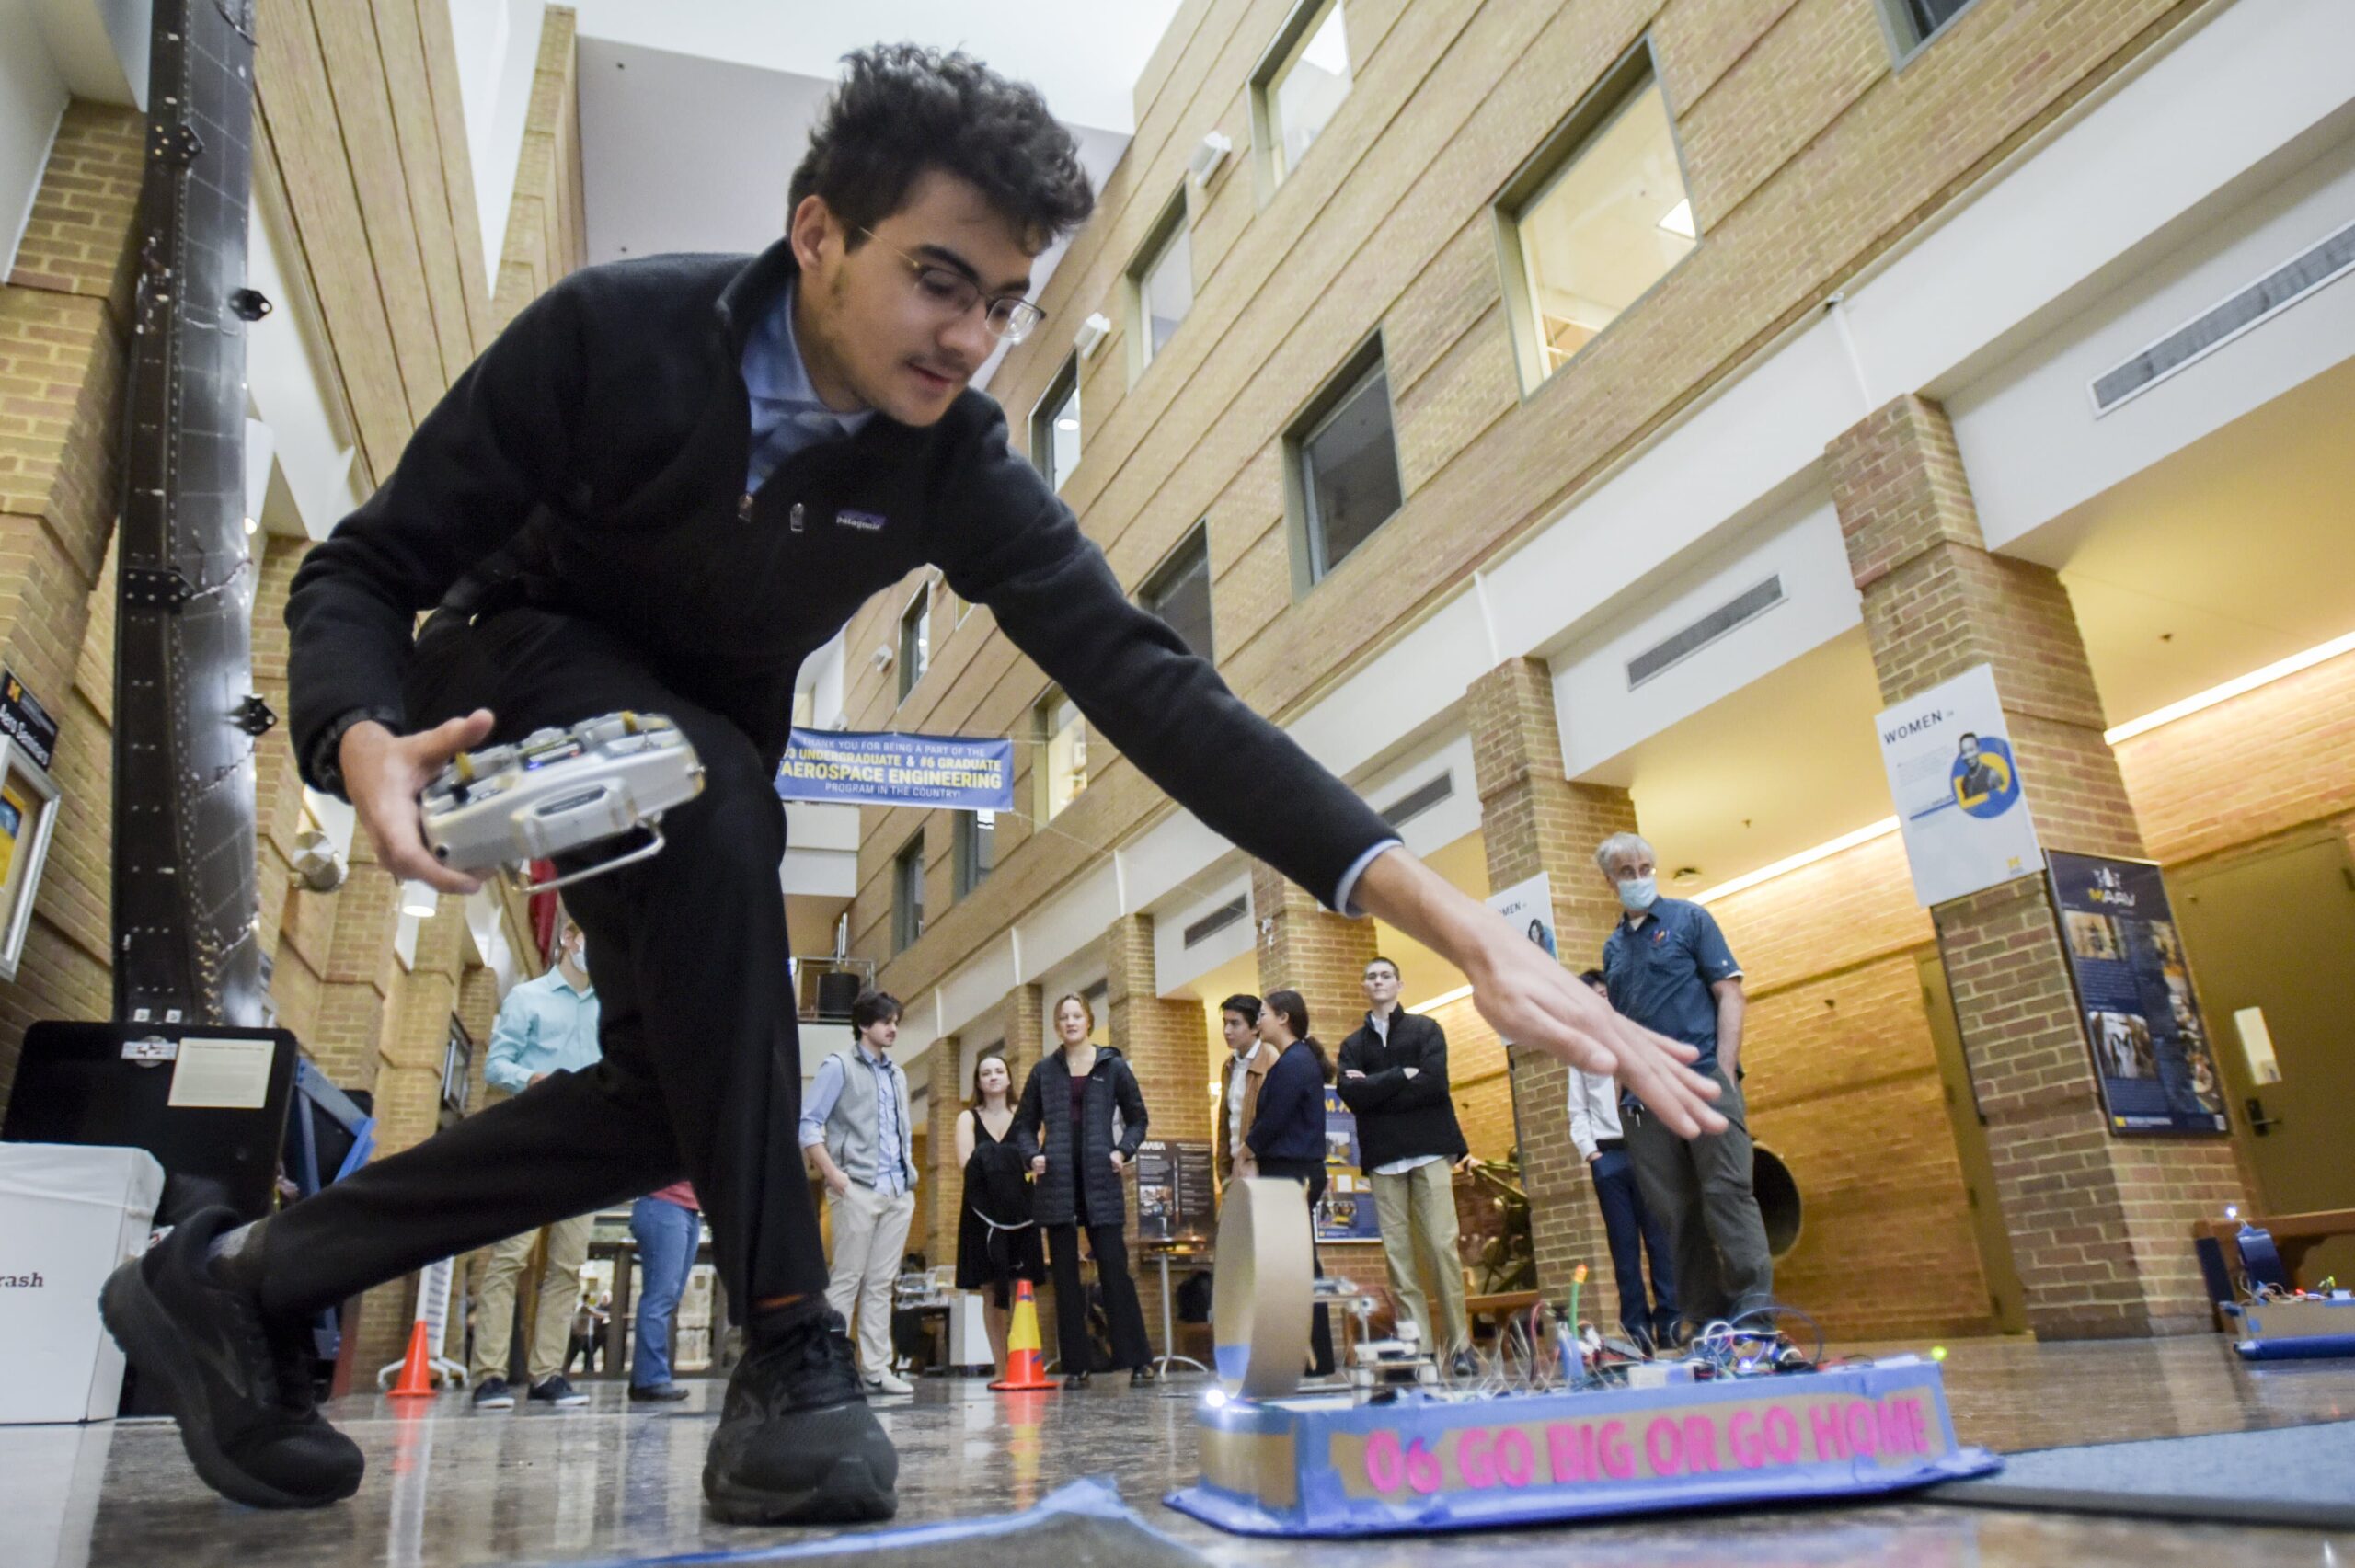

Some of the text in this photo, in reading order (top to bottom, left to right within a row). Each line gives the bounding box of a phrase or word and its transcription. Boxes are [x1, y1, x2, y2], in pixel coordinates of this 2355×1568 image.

[1884, 710, 1943, 744] WOMEN
[802, 738, 834, 749] THANK
[838, 740, 857, 750] YOU
[861, 741, 880, 751] FOR
[883, 742, 912, 752] BEING
[925, 745, 948, 754] PART
[951, 747, 963, 755] OF
[967, 748, 985, 757] THE
[799, 749, 901, 766] UNDERGRADUATE
[906, 755, 915, 767] &
[920, 756, 935, 768] #6
[937, 758, 1002, 772] GRADUATE
[780, 761, 1003, 789] AEROSPACE ENGINEERING
[825, 782, 874, 794] PROGRAM
[877, 785, 888, 795] IN
[890, 786, 910, 796] THE
[1499, 901, 1521, 916] MEN
[0, 1272, 44, 1288] rash
[1459, 1427, 1534, 1489] GO
[1546, 1420, 1637, 1483] BIG
[1646, 1415, 1721, 1477] OR
[1728, 1404, 1800, 1469] GO
[1809, 1397, 1930, 1461] HOME
